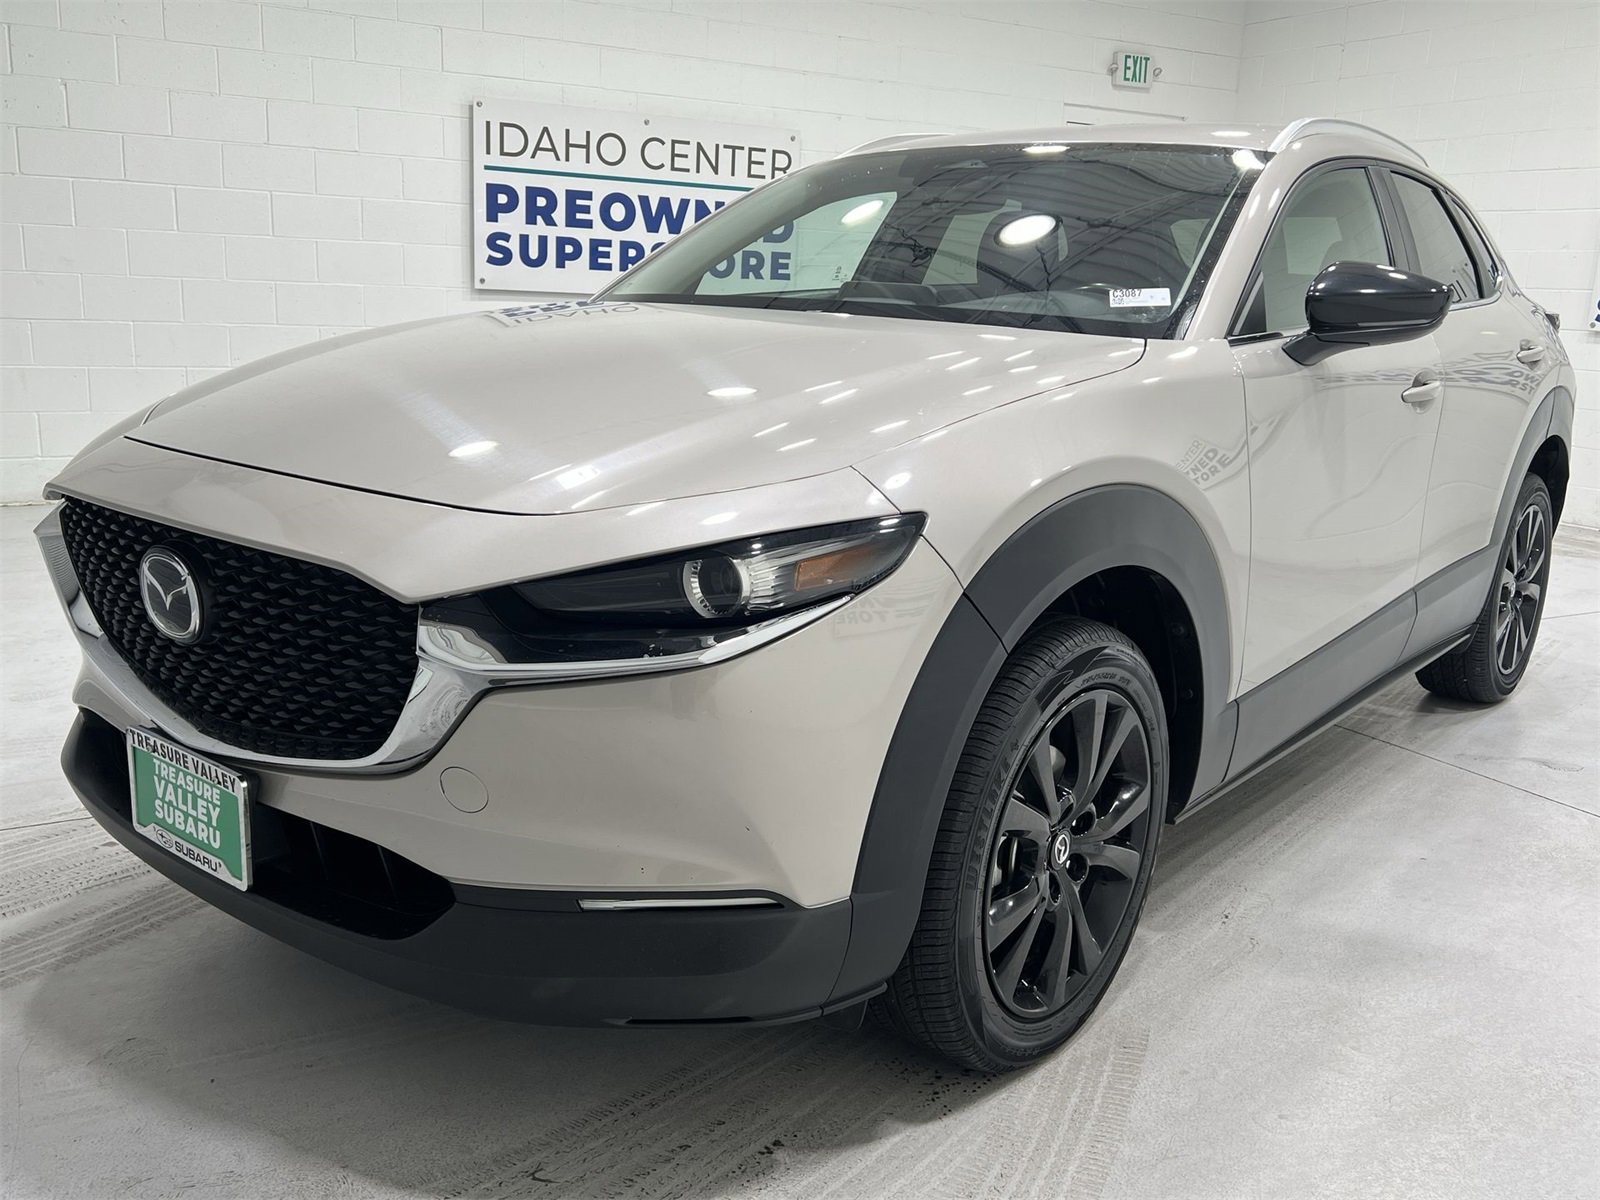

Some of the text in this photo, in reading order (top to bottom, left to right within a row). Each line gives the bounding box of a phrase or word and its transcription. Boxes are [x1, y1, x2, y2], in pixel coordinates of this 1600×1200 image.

[1123, 54, 1151, 84] EXIT
[485, 120, 793, 180] IDAHO CENTER
[485, 231, 792, 281] SUPERORE
[129, 730, 237, 793] TREASURE VALLEY
[152, 758, 221, 806] TREASURE
[153, 775, 221, 828] VALLEY
[154, 798, 221, 849] SUBARU
